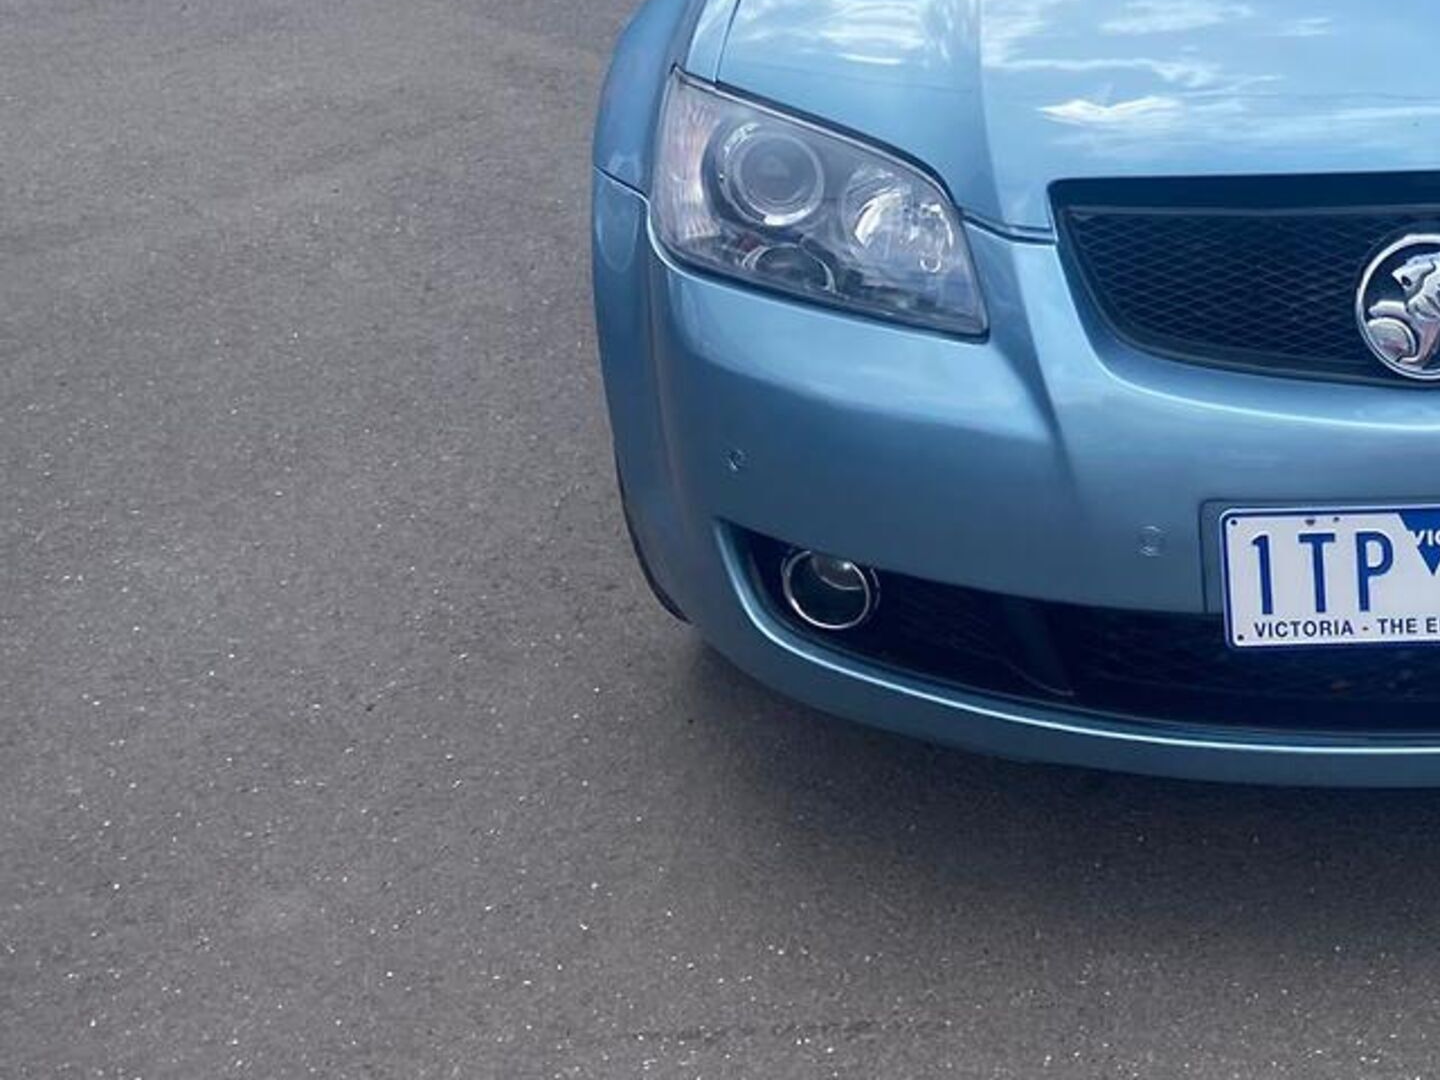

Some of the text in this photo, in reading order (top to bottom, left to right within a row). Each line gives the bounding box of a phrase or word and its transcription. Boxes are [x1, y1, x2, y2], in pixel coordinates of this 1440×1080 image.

[1251, 531, 1394, 615] 1TP
[1254, 620, 1354, 638] VICTORIA
[1376, 618, 1418, 635] THE
